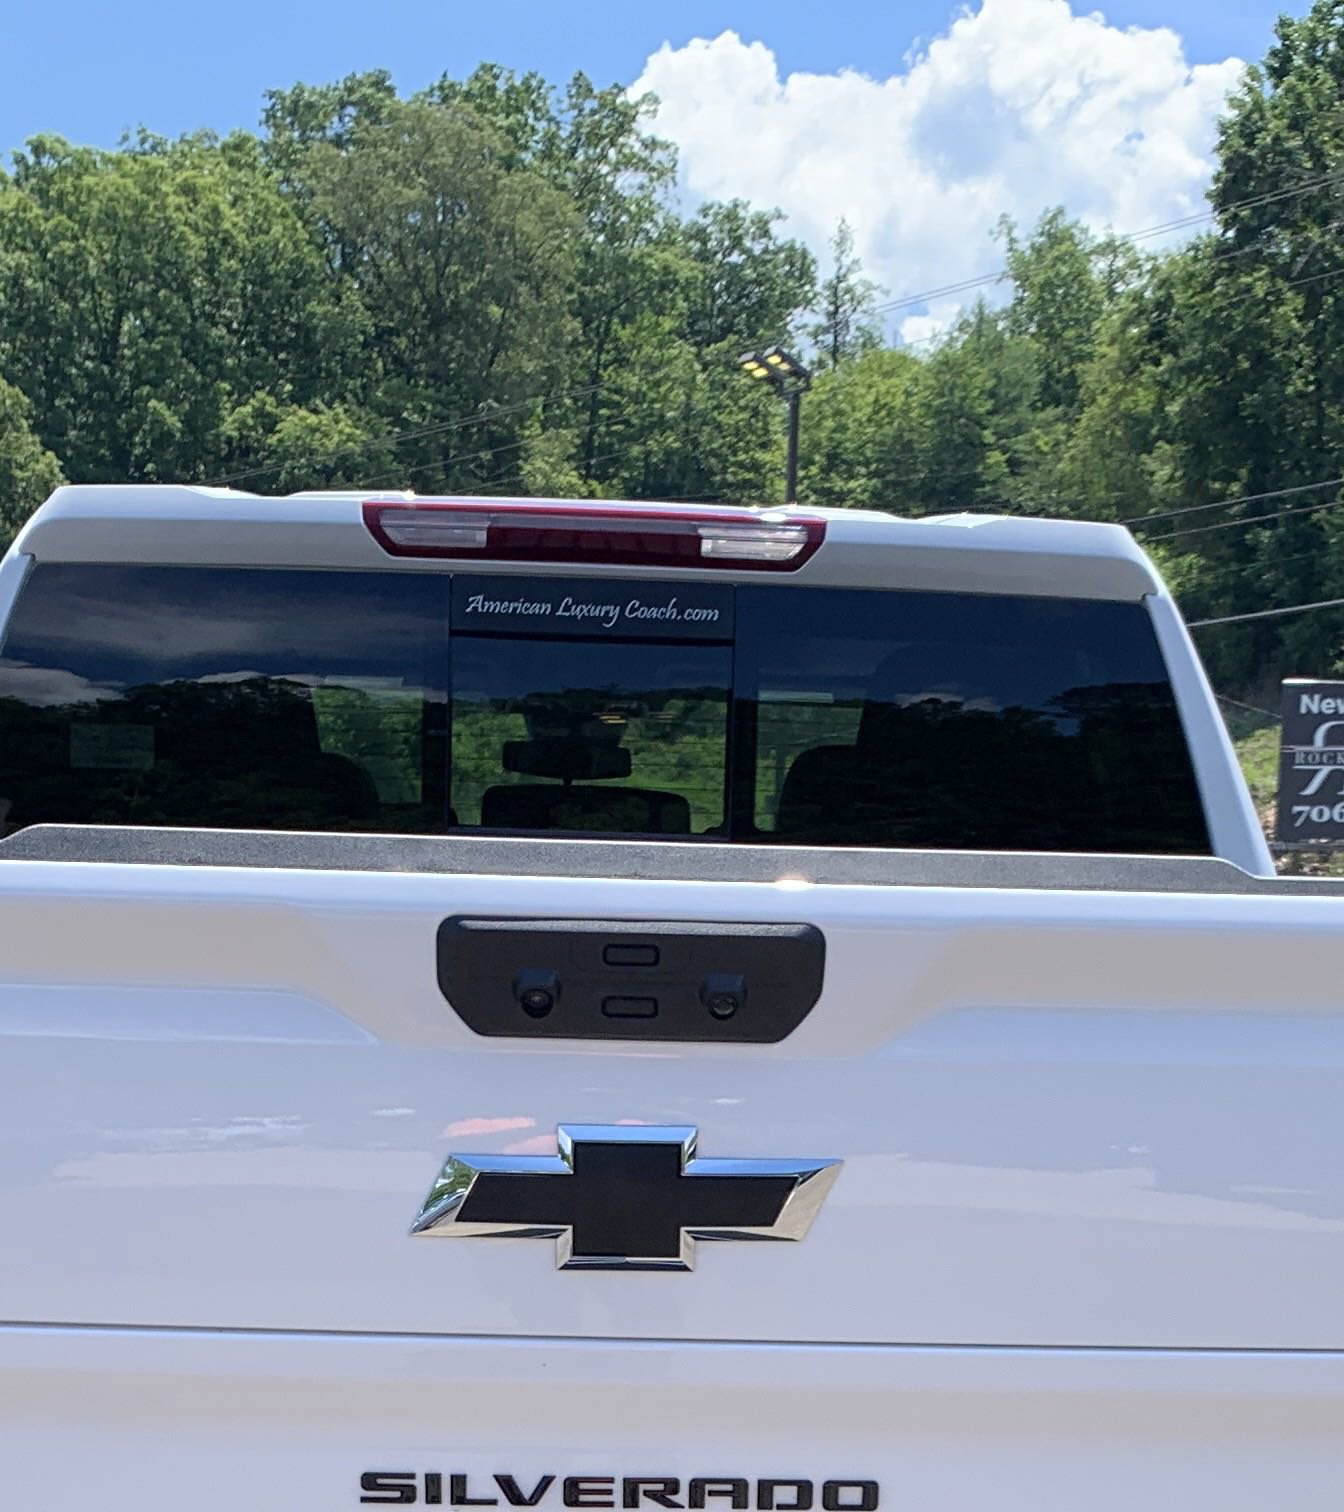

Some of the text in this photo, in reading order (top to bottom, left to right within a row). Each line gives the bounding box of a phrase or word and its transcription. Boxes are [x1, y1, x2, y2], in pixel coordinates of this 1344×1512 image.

[465, 594, 720, 627] American Luxury Coach.com
[359, 1471, 880, 1512] SILVERADO
